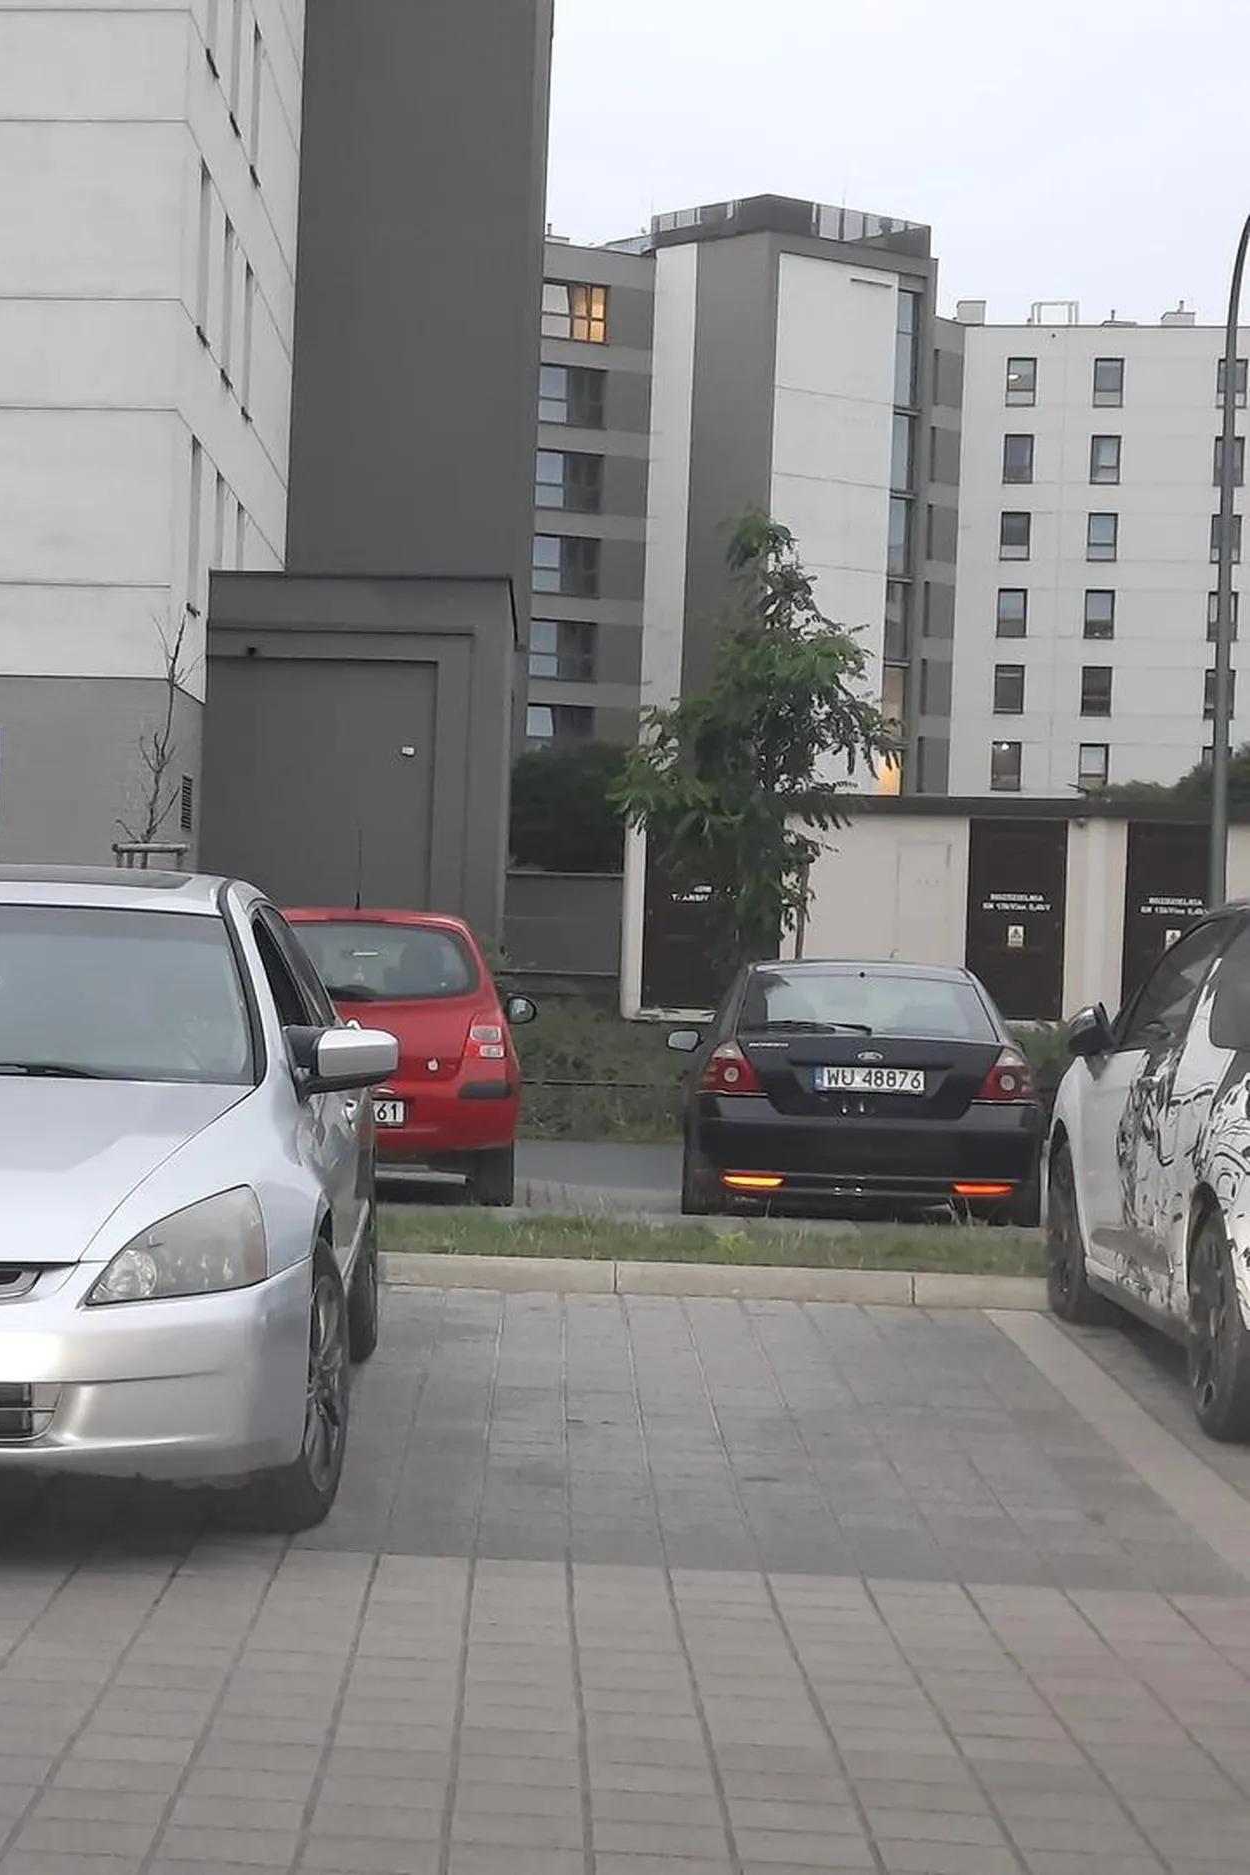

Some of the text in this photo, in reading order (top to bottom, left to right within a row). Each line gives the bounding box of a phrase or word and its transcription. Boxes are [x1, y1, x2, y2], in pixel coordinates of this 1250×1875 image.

[827, 1068, 922, 1090] WU 48876
[376, 1103, 398, 1121] 61
